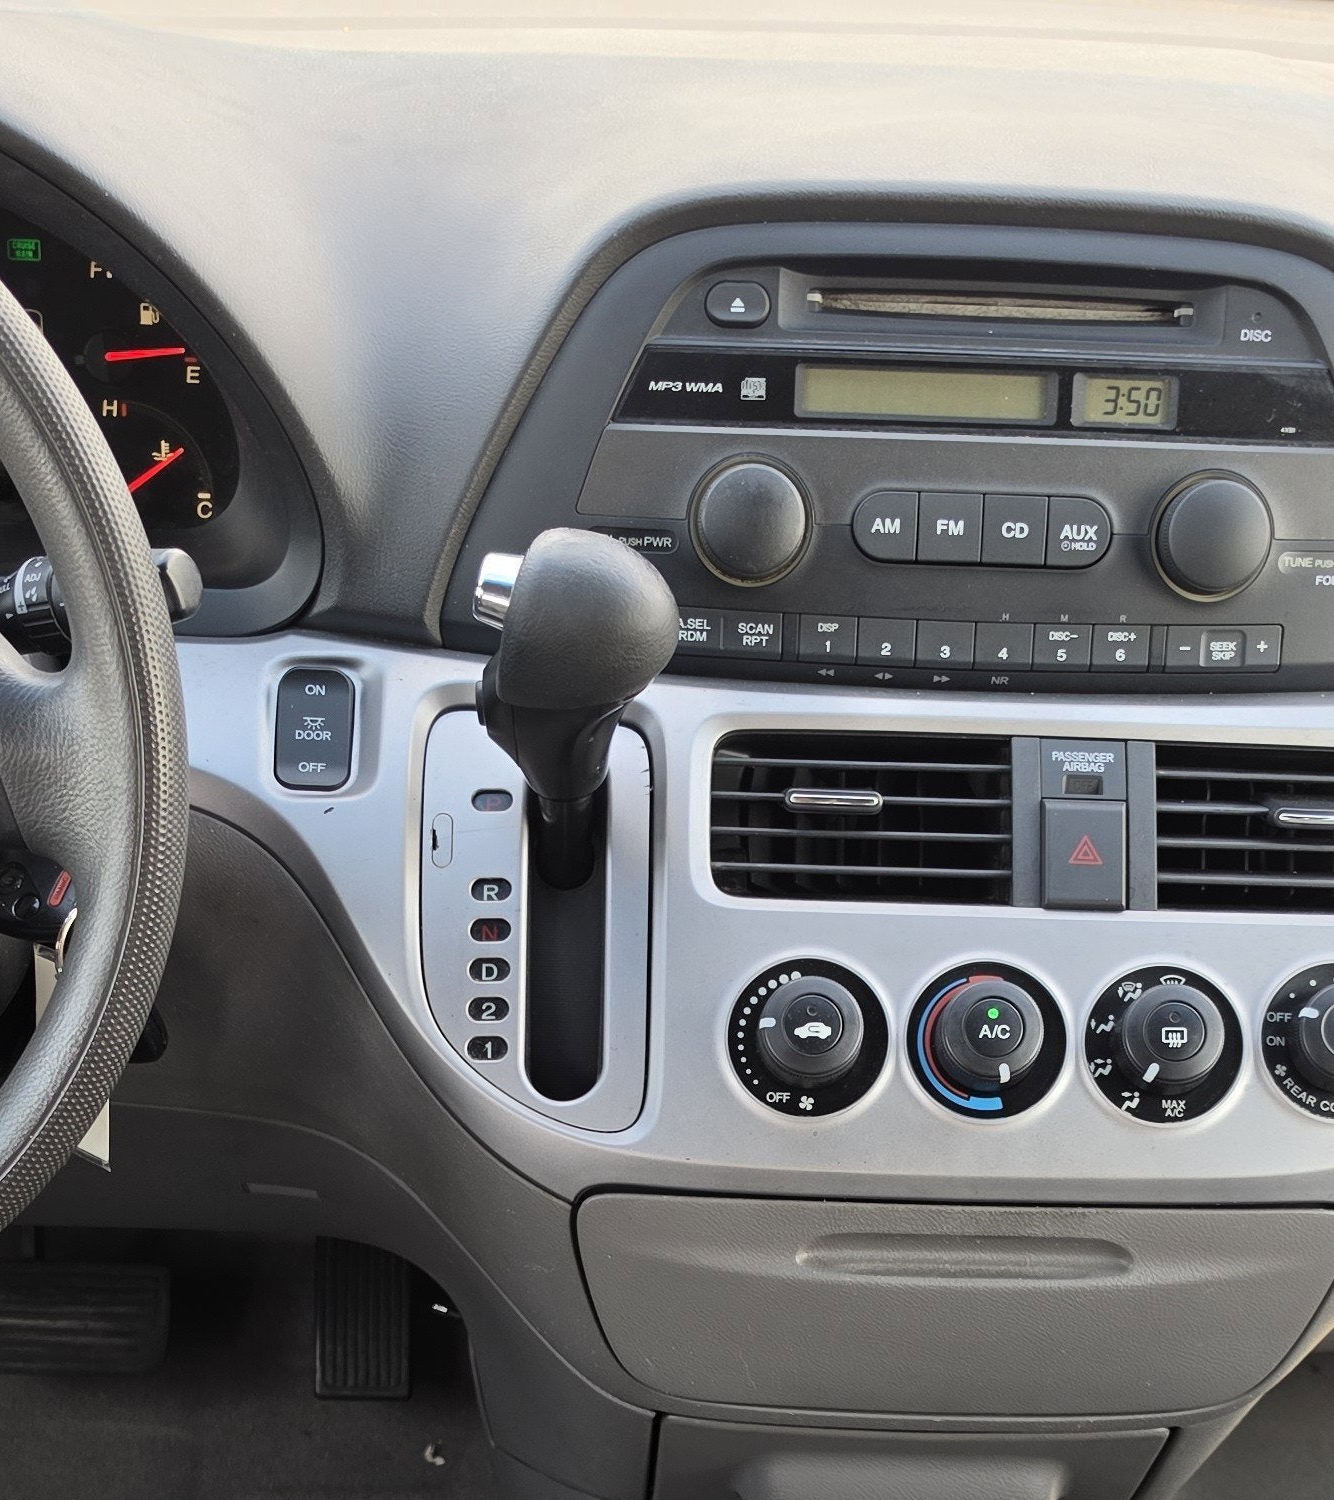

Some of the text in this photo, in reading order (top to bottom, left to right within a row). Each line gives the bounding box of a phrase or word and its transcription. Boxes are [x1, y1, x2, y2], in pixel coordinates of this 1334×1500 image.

[1240, 329, 1272, 343] DISC
[186, 366, 200, 384] E
[648, 381, 723, 393] MP3 WMA
[1103, 385, 1162, 417] 3:50
[102, 400, 117, 417] H
[196, 502, 213, 519] C
[871, 518, 900, 534] AM
[936, 519, 964, 536] FM
[1001, 522, 1029, 539] CD
[1059, 524, 1098, 540] AUX
[644, 536, 672, 548] PWR
[1071, 541, 1097, 550] HOLD
[1284, 557, 1313, 568] TUNE
[24, 572, 42, 582] ADJ
[1060, 614, 1068, 622] M
[1120, 614, 1128, 623] R
[738, 623, 773, 635] SCAN
[817, 623, 839, 632] DISP
[678, 630, 707, 641] RDM
[742, 635, 769, 647] RPT
[824, 640, 832, 653] 1
[880, 643, 892, 656] 2
[939, 645, 951, 659] 3
[1209, 641, 1237, 652] SEEK
[997, 647, 1009, 660] 4
[1056, 649, 1067, 662] 5
[1115, 649, 1126, 662] 6
[1211, 650, 1235, 662] SKIP
[990, 676, 1009, 685] NR
[305, 684, 326, 696] ON
[295, 729, 331, 741] DOOR
[1051, 751, 1115, 763] PASSENGER
[298, 761, 327, 773] OFF
[1063, 761, 1105, 773] AIRBAG
[483, 884, 499, 900] R
[482, 925, 498, 941] N
[481, 963, 498, 980] D
[481, 1002, 496, 1019] 2
[1266, 1012, 1292, 1023] OFF
[978, 1024, 1011, 1040] A/C
[1266, 1036, 1285, 1047] ON
[483, 1041, 492, 1059] 1
[766, 1092, 791, 1103] OFF
[1284, 1077, 1316, 1108] REAR
[1162, 1100, 1186, 1110] MAX
[1165, 1108, 1183, 1118] A/C
